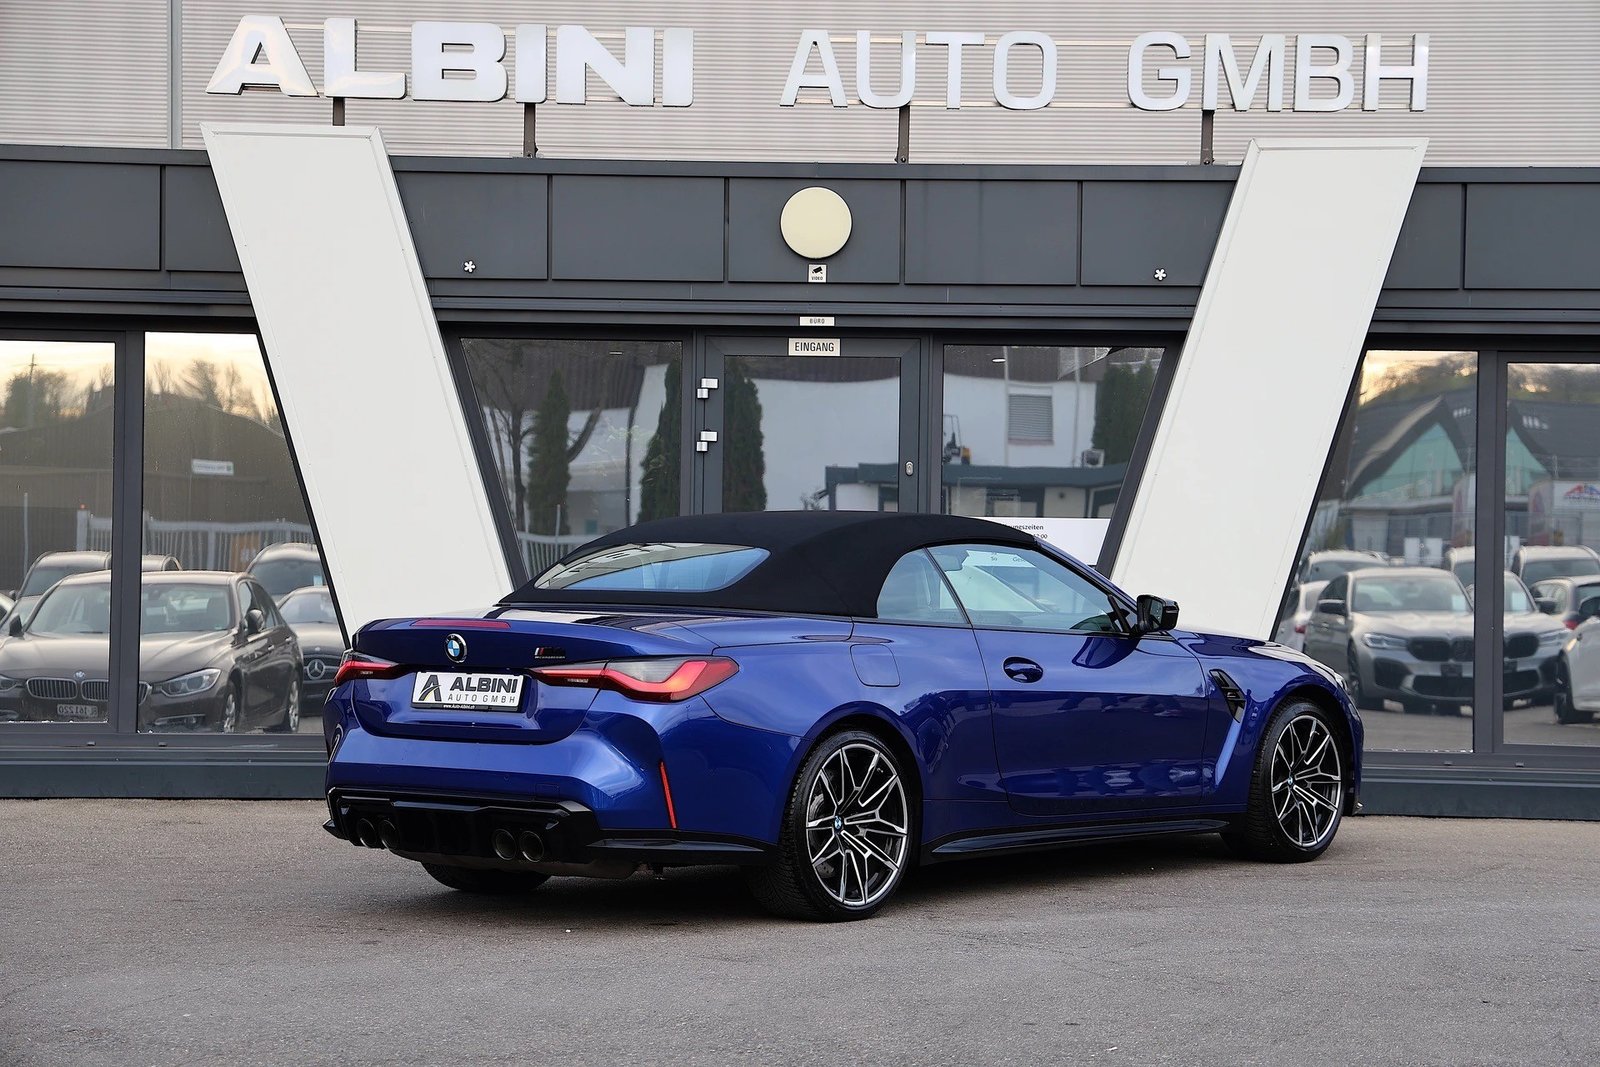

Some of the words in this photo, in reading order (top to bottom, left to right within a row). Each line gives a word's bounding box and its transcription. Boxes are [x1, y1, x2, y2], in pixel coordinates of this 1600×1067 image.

[205, 15, 695, 107] ALBINI
[779, 29, 1058, 110] AUTO
[1126, 31, 1430, 112] GMBH
[794, 341, 835, 352] EINGANG
[450, 676, 518, 694] ALBINI
[447, 693, 478, 703] AUTO
[482, 694, 516, 704] GMBH
